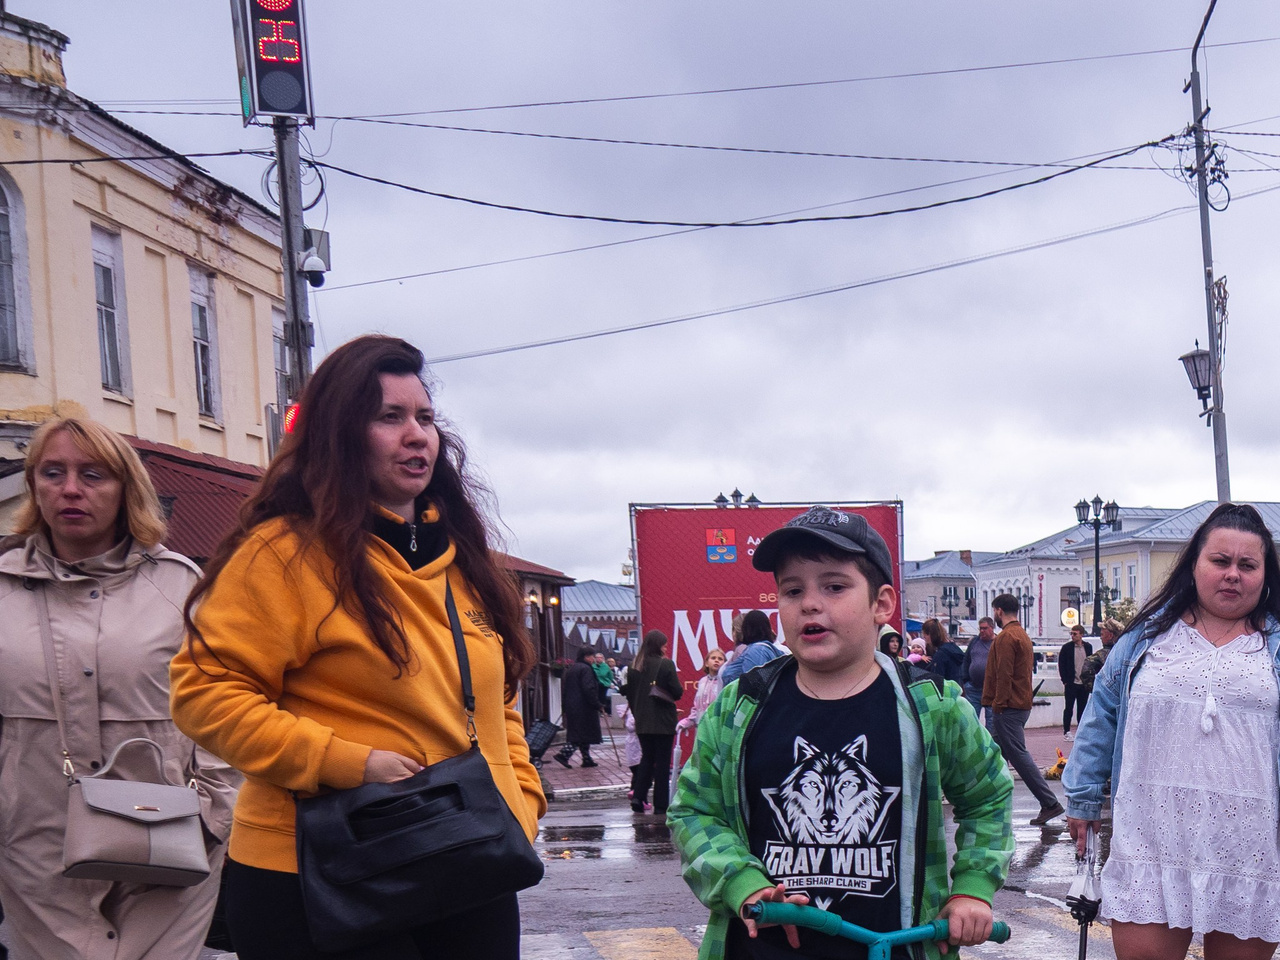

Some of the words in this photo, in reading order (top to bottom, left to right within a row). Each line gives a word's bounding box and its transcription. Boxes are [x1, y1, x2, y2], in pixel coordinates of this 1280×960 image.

[766, 845, 825, 876] GRAY
[831, 845, 892, 878] WOLF
[786, 878, 804, 887] THE
[806, 877, 834, 886] SHARP
[836, 878, 867, 889] CLAWS
